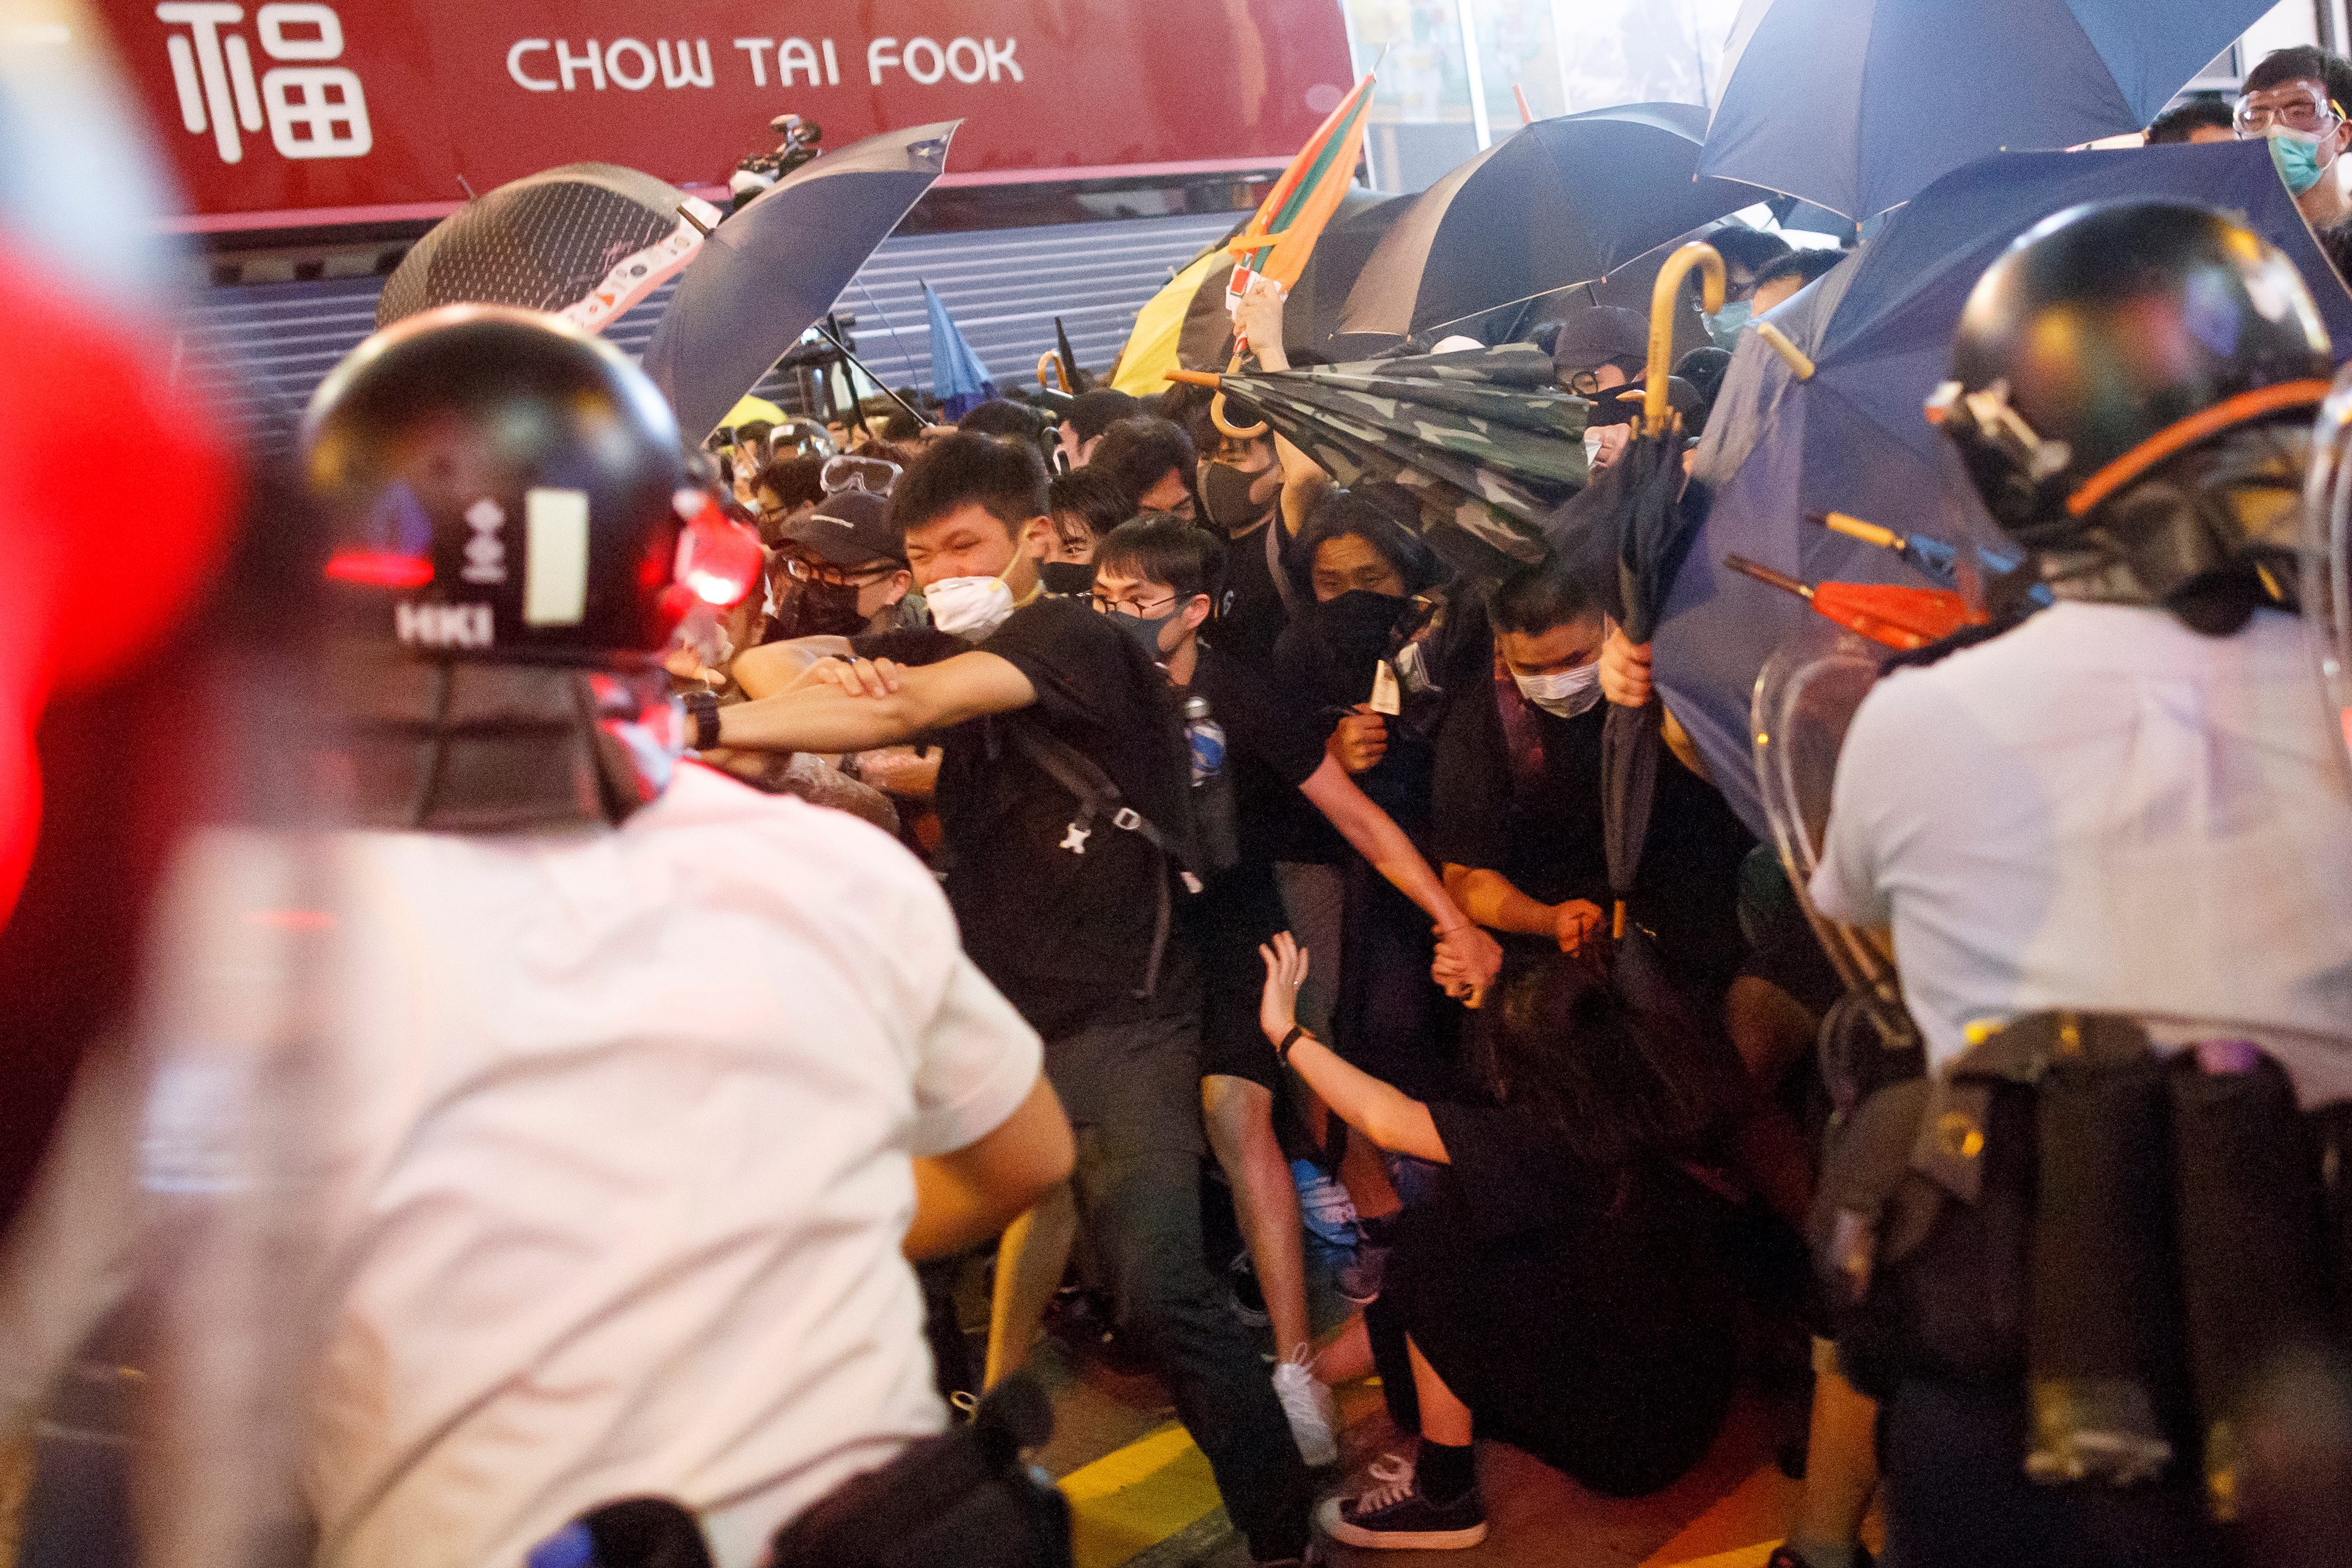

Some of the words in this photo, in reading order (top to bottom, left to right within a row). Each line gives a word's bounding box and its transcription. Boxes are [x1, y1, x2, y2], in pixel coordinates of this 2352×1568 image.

[156, 2, 373, 163] 福
[507, 37, 714, 91] CHOW
[733, 37, 841, 86] TAI
[866, 36, 1024, 85] FOOK
